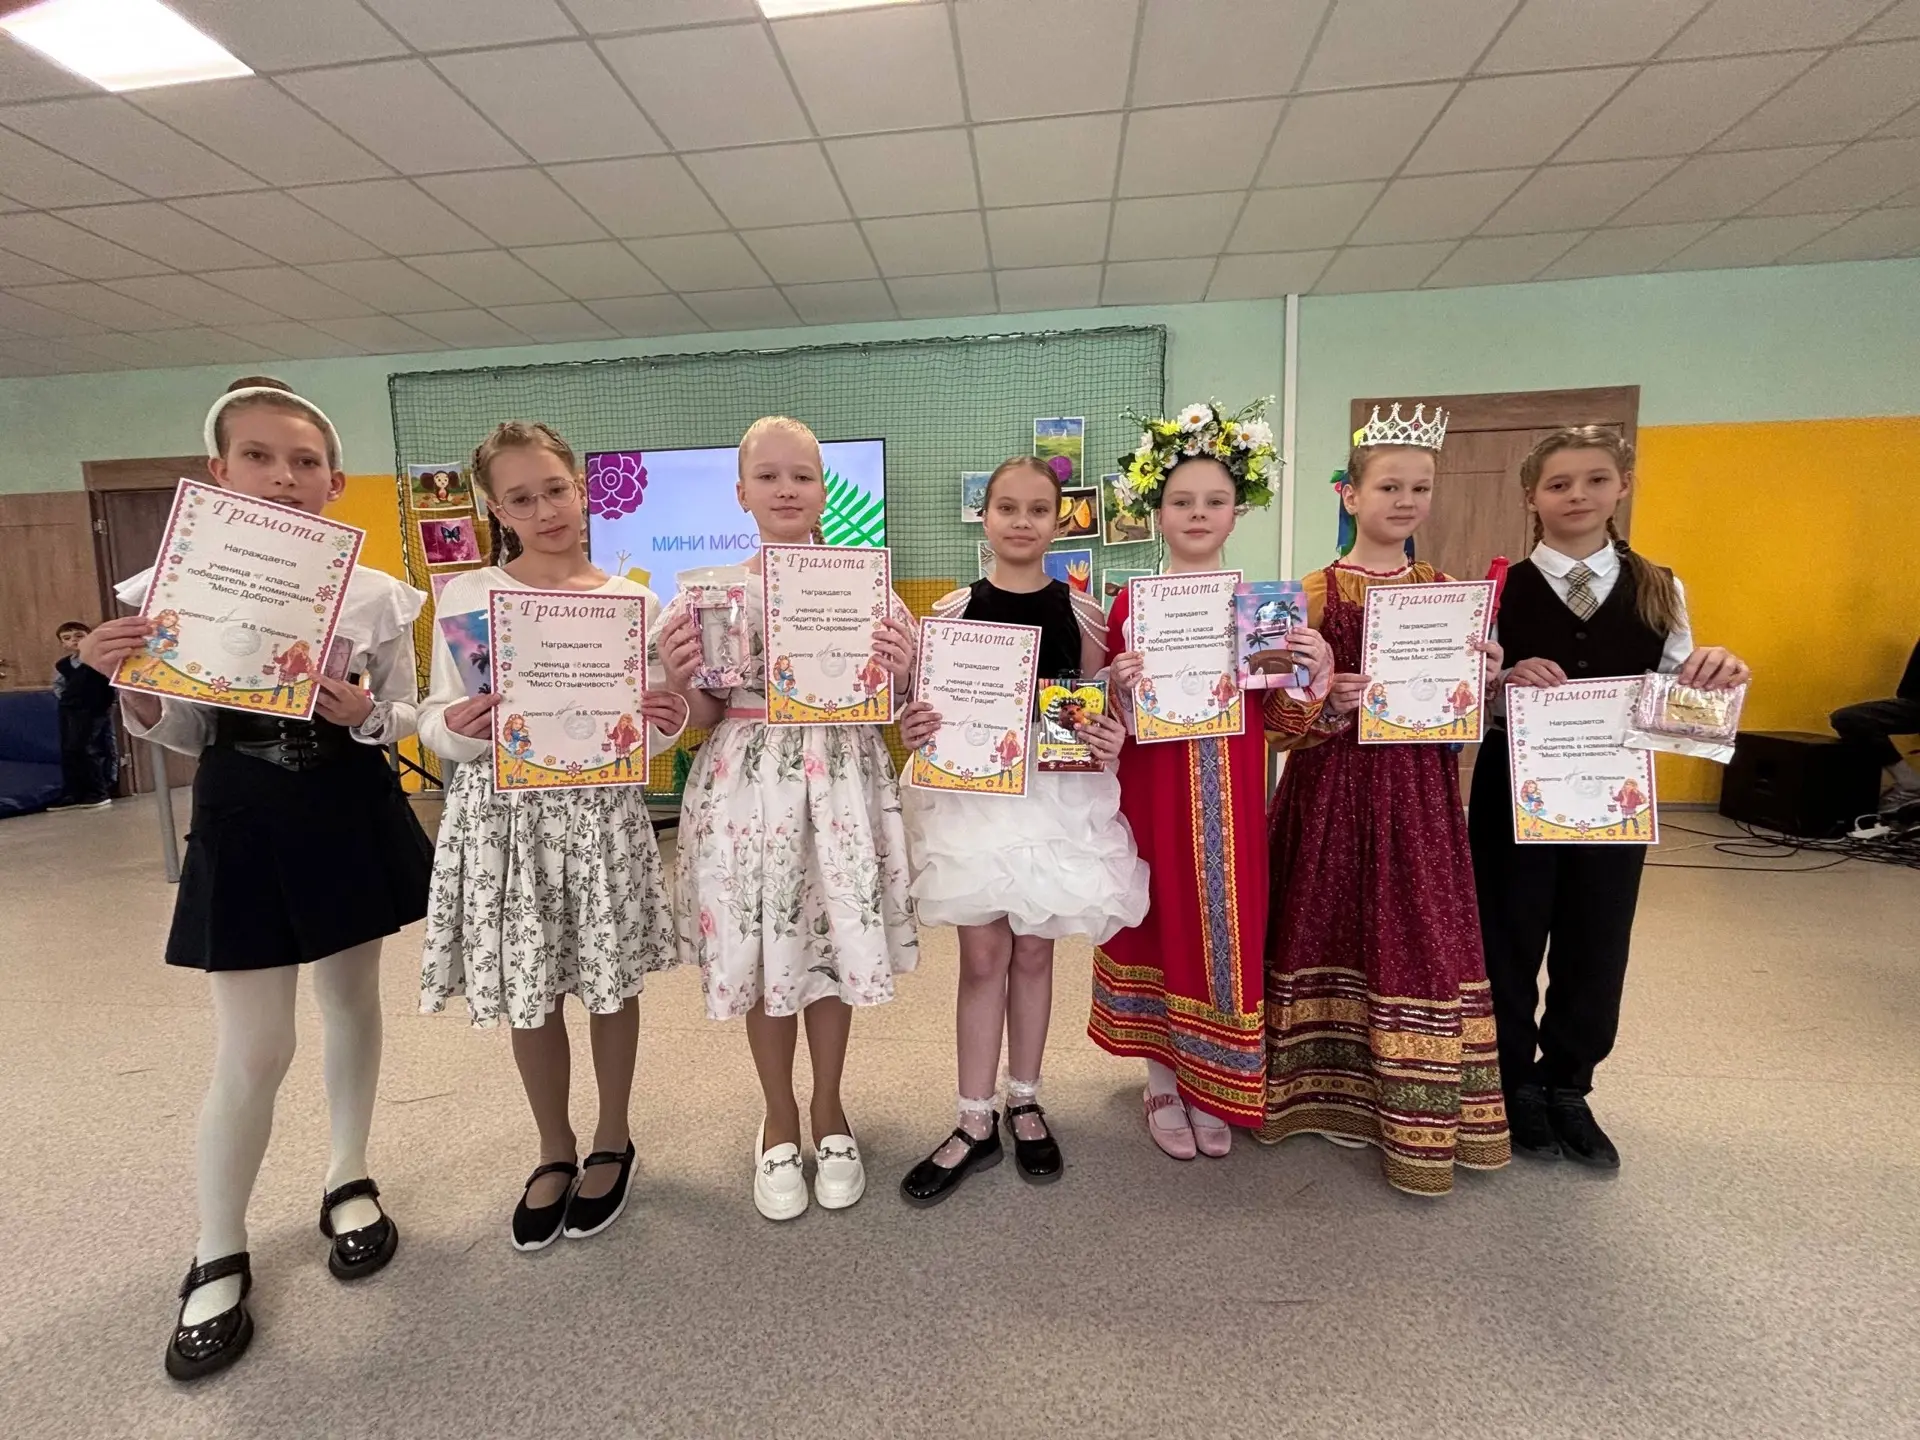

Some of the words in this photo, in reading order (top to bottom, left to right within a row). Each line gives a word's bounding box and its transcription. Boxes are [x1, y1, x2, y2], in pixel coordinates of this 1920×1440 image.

[212, 500, 325, 543] Грамота
[653, 534, 704, 551] МИНИ
[710, 533, 761, 550] МИСС
[224, 543, 297, 568] Награждается
[786, 553, 864, 572] Грамота
[209, 562, 251, 577] ученица
[266, 575, 300, 589] класса
[187, 567, 247, 587] победитель
[259, 584, 315, 603] номинации
[1151, 583, 1220, 600] Грамота
[1388, 592, 1466, 610] Грамота
[178, 609, 215, 622] Директор
[520, 600, 617, 622] Грамота
[1165, 610, 1208, 619] Награждается
[1159, 628, 1184, 636] ученица
[1399, 622, 1448, 630] Награждается
[942, 627, 1015, 646] Грамота
[1149, 636, 1184, 644] победитель
[1392, 639, 1420, 647] ученица
[541, 641, 602, 649] Награждается
[534, 661, 569, 669] ученица
[953, 661, 1000, 671] Награждается
[518, 670, 569, 678] победитель
[946, 678, 972, 686] ученица
[933, 685, 972, 695] победитель
[979, 690, 1014, 698] номинации
[1532, 689, 1617, 706] Грамота
[1543, 735, 1574, 743] ученица
